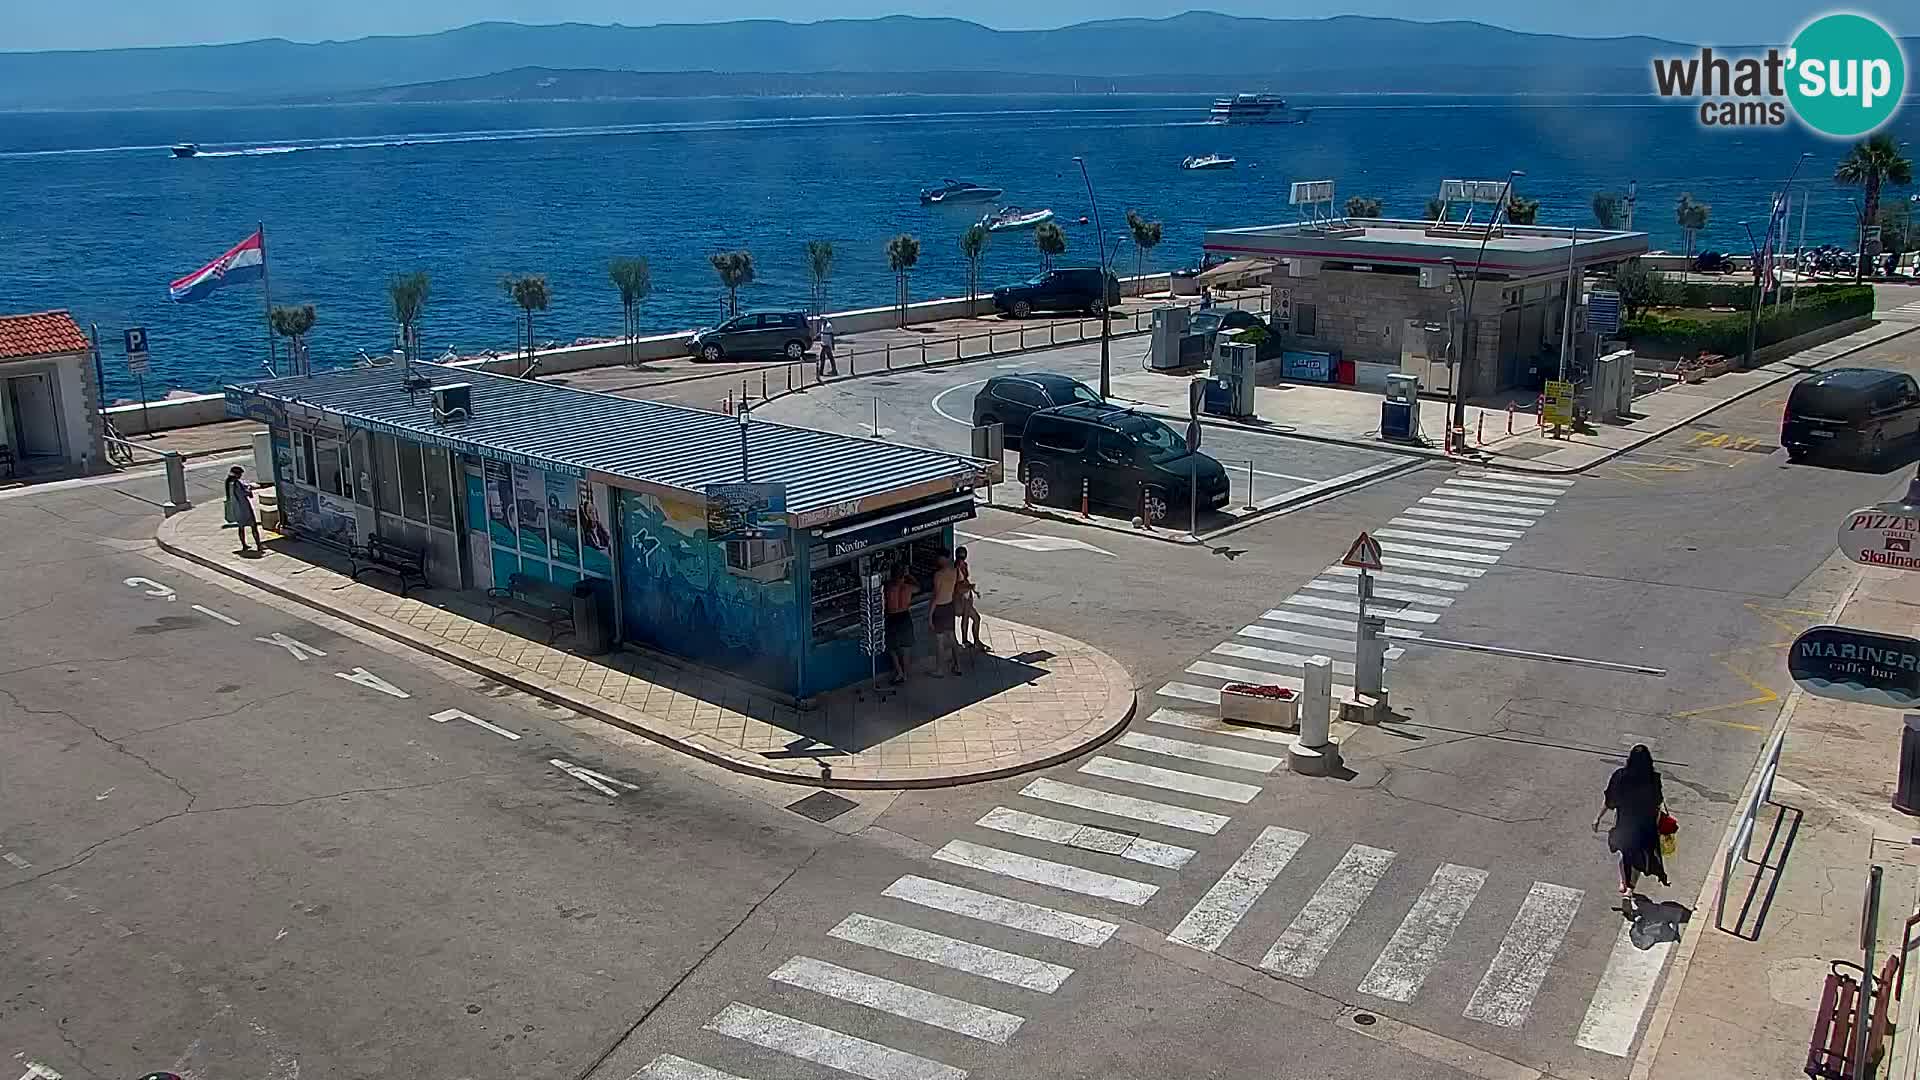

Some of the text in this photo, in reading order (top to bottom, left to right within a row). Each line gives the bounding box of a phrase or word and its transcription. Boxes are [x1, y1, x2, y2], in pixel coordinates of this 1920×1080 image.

[129, 331, 142, 349] P
[395, 428, 435, 444] AUTOBUSNA
[478, 446, 493, 457] BUS
[493, 449, 526, 465] STATION
[527, 457, 554, 471] TICKET
[555, 463, 582, 477] OFFICE
[1849, 514, 1920, 532] PIZZE
[1871, 664, 1897, 680] bar
